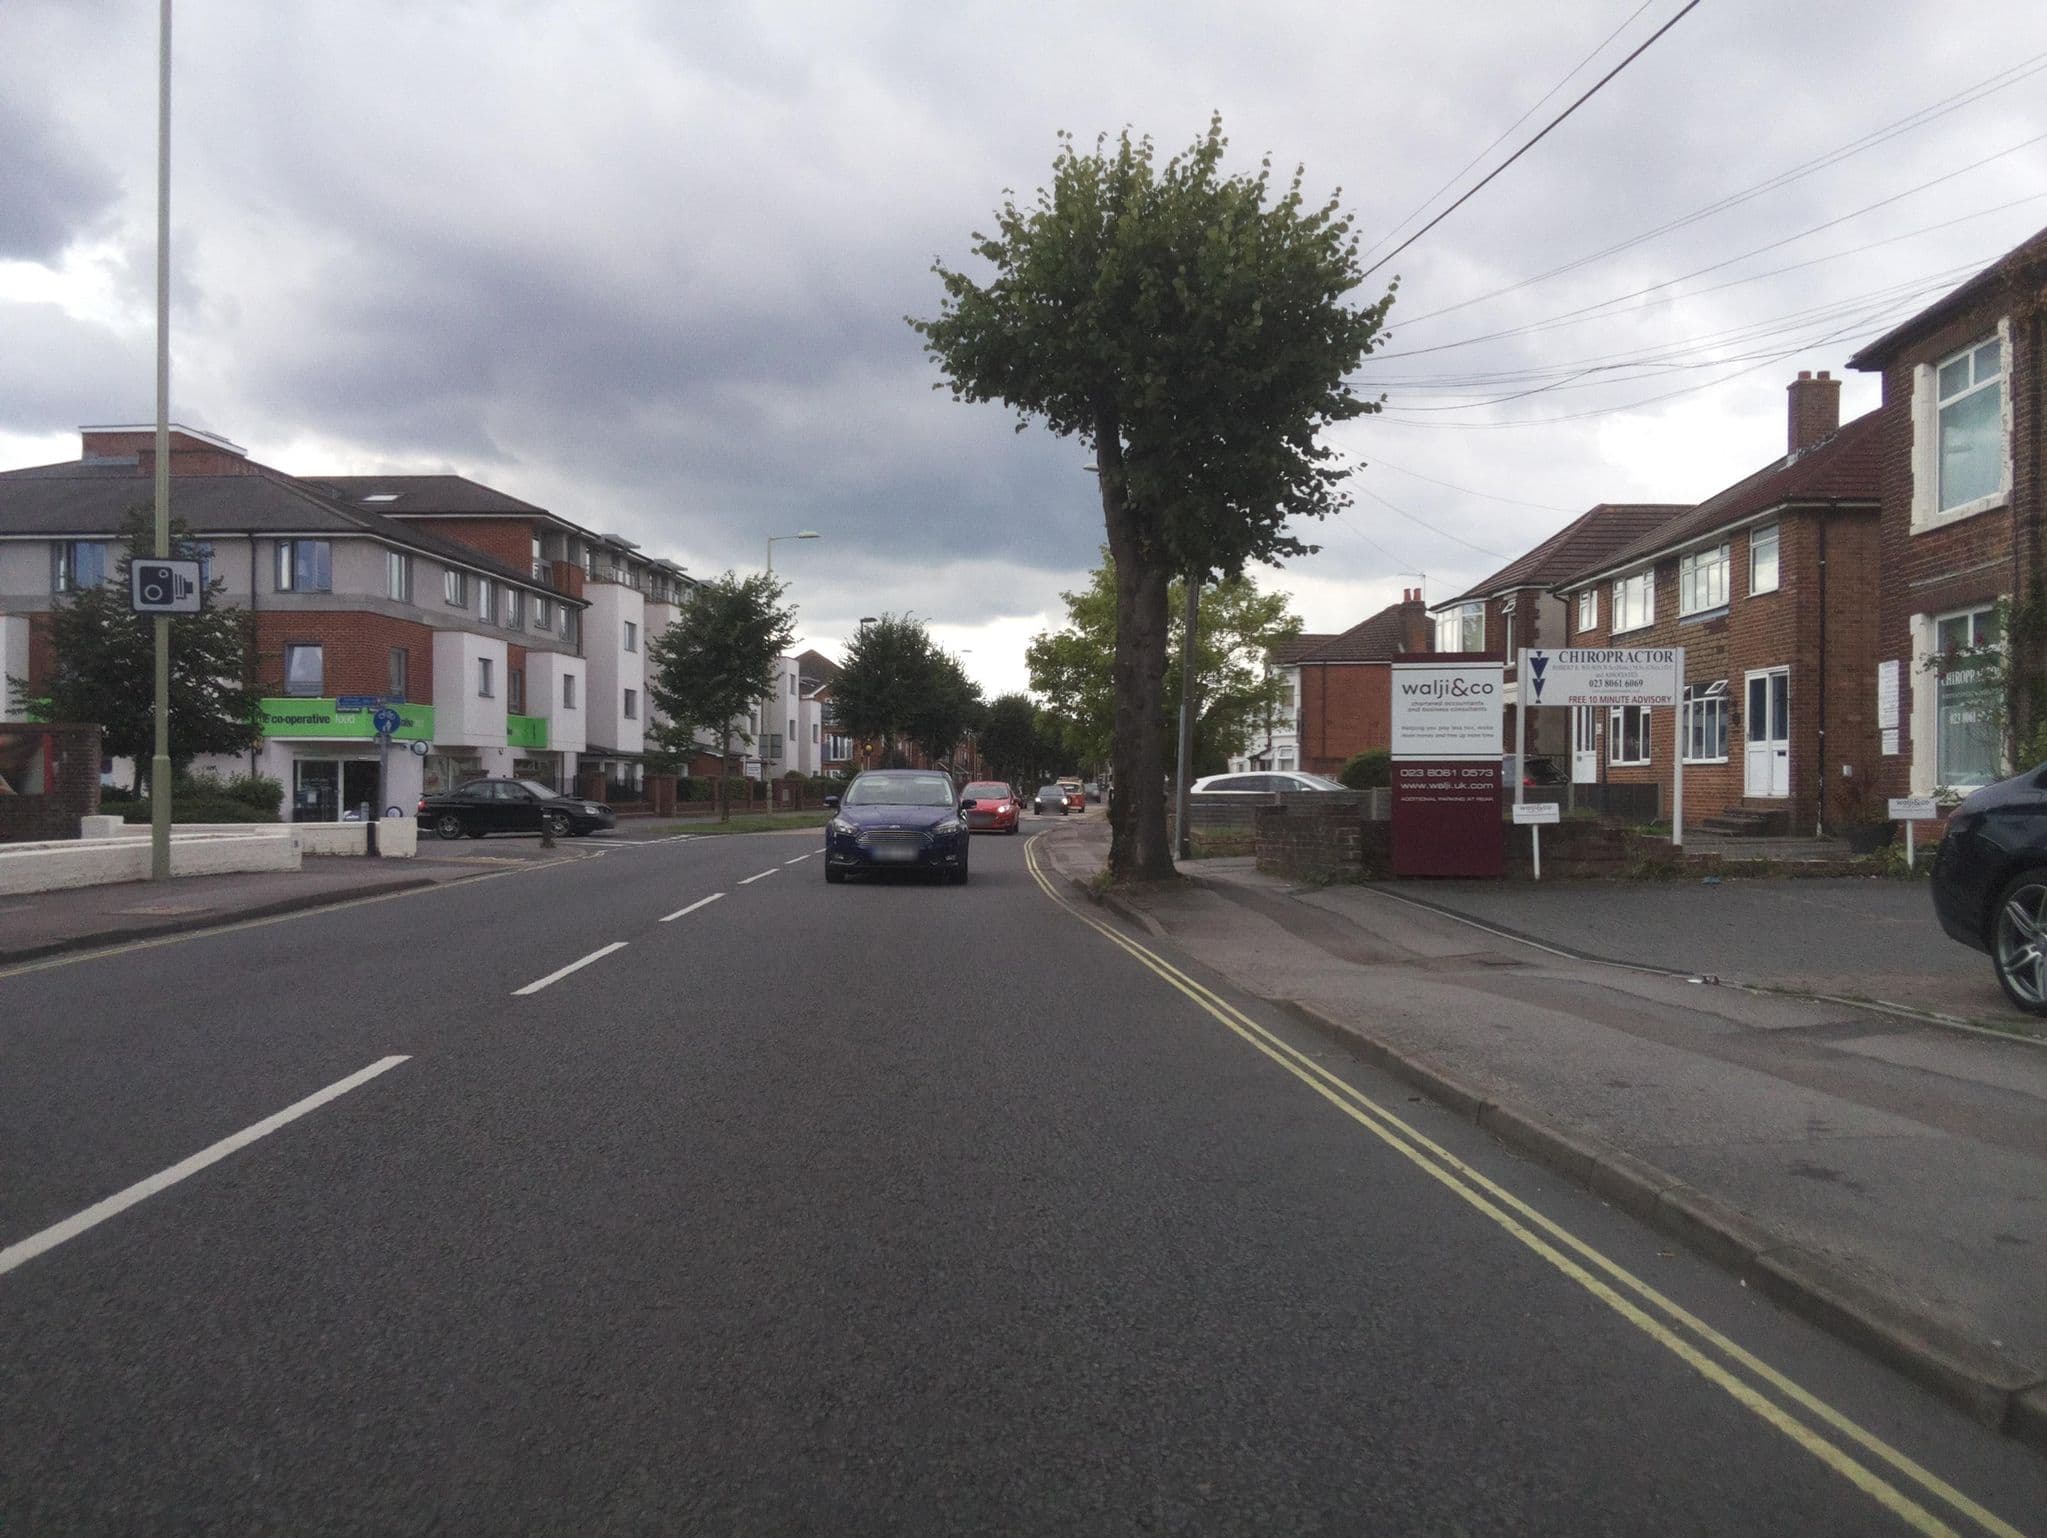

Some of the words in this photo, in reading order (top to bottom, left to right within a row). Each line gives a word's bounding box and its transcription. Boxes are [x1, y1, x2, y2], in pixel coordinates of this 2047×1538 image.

[1558, 650, 1674, 663] CHIROPRACTOR
[1402, 677, 1494, 699] walji&co
[1588, 679, 1603, 688] 023
[1604, 679, 1622, 688] 8061
[1624, 679, 1644, 688] 6069
[1568, 695, 1587, 704] FREE
[1589, 695, 1598, 704] 10
[1600, 695, 1630, 704] MINUTE
[1632, 695, 1672, 704] ADVISORY
[271, 713, 331, 726] co-operative
[1400, 768, 1424, 777] 023
[1427, 768, 1457, 777] 8061
[1461, 768, 1494, 777] 0573
